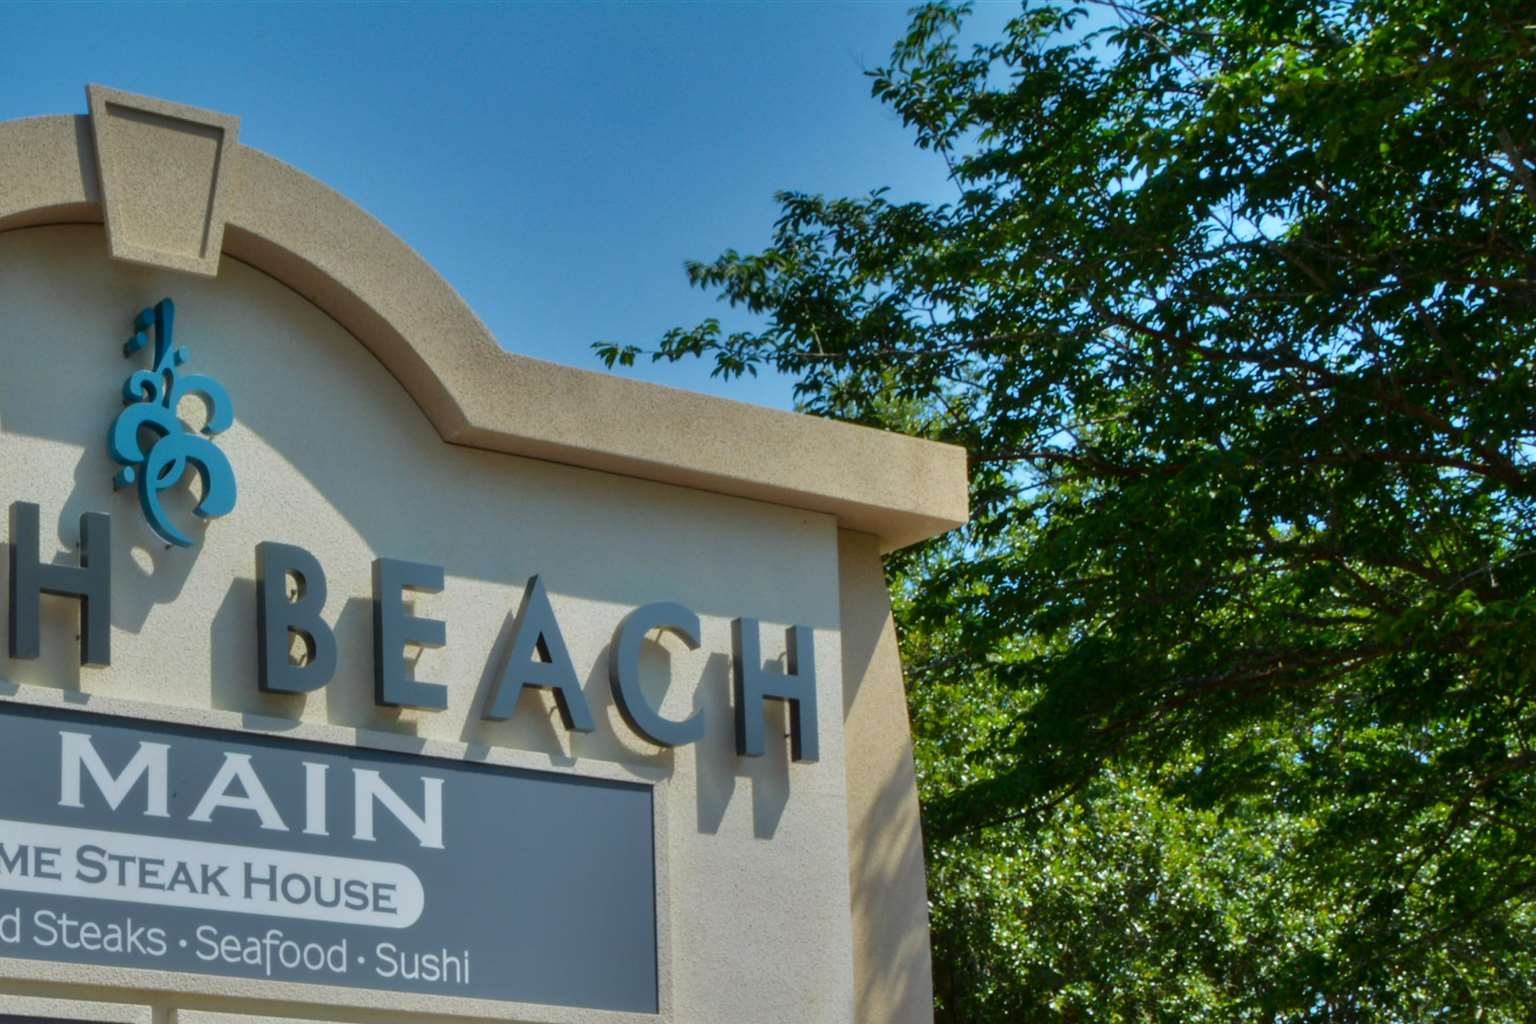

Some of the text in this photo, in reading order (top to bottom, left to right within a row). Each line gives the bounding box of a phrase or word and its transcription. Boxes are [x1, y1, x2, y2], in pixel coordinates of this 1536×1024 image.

[256, 541, 819, 762] BEACH
[57, 730, 445, 849] MAIN
[75, 844, 229, 897] STEAK
[242, 861, 397, 914] HOUSE
[33, 909, 167, 956] Steaks
[195, 925, 347, 976] Seafood
[376, 942, 470, 985] Sushi
